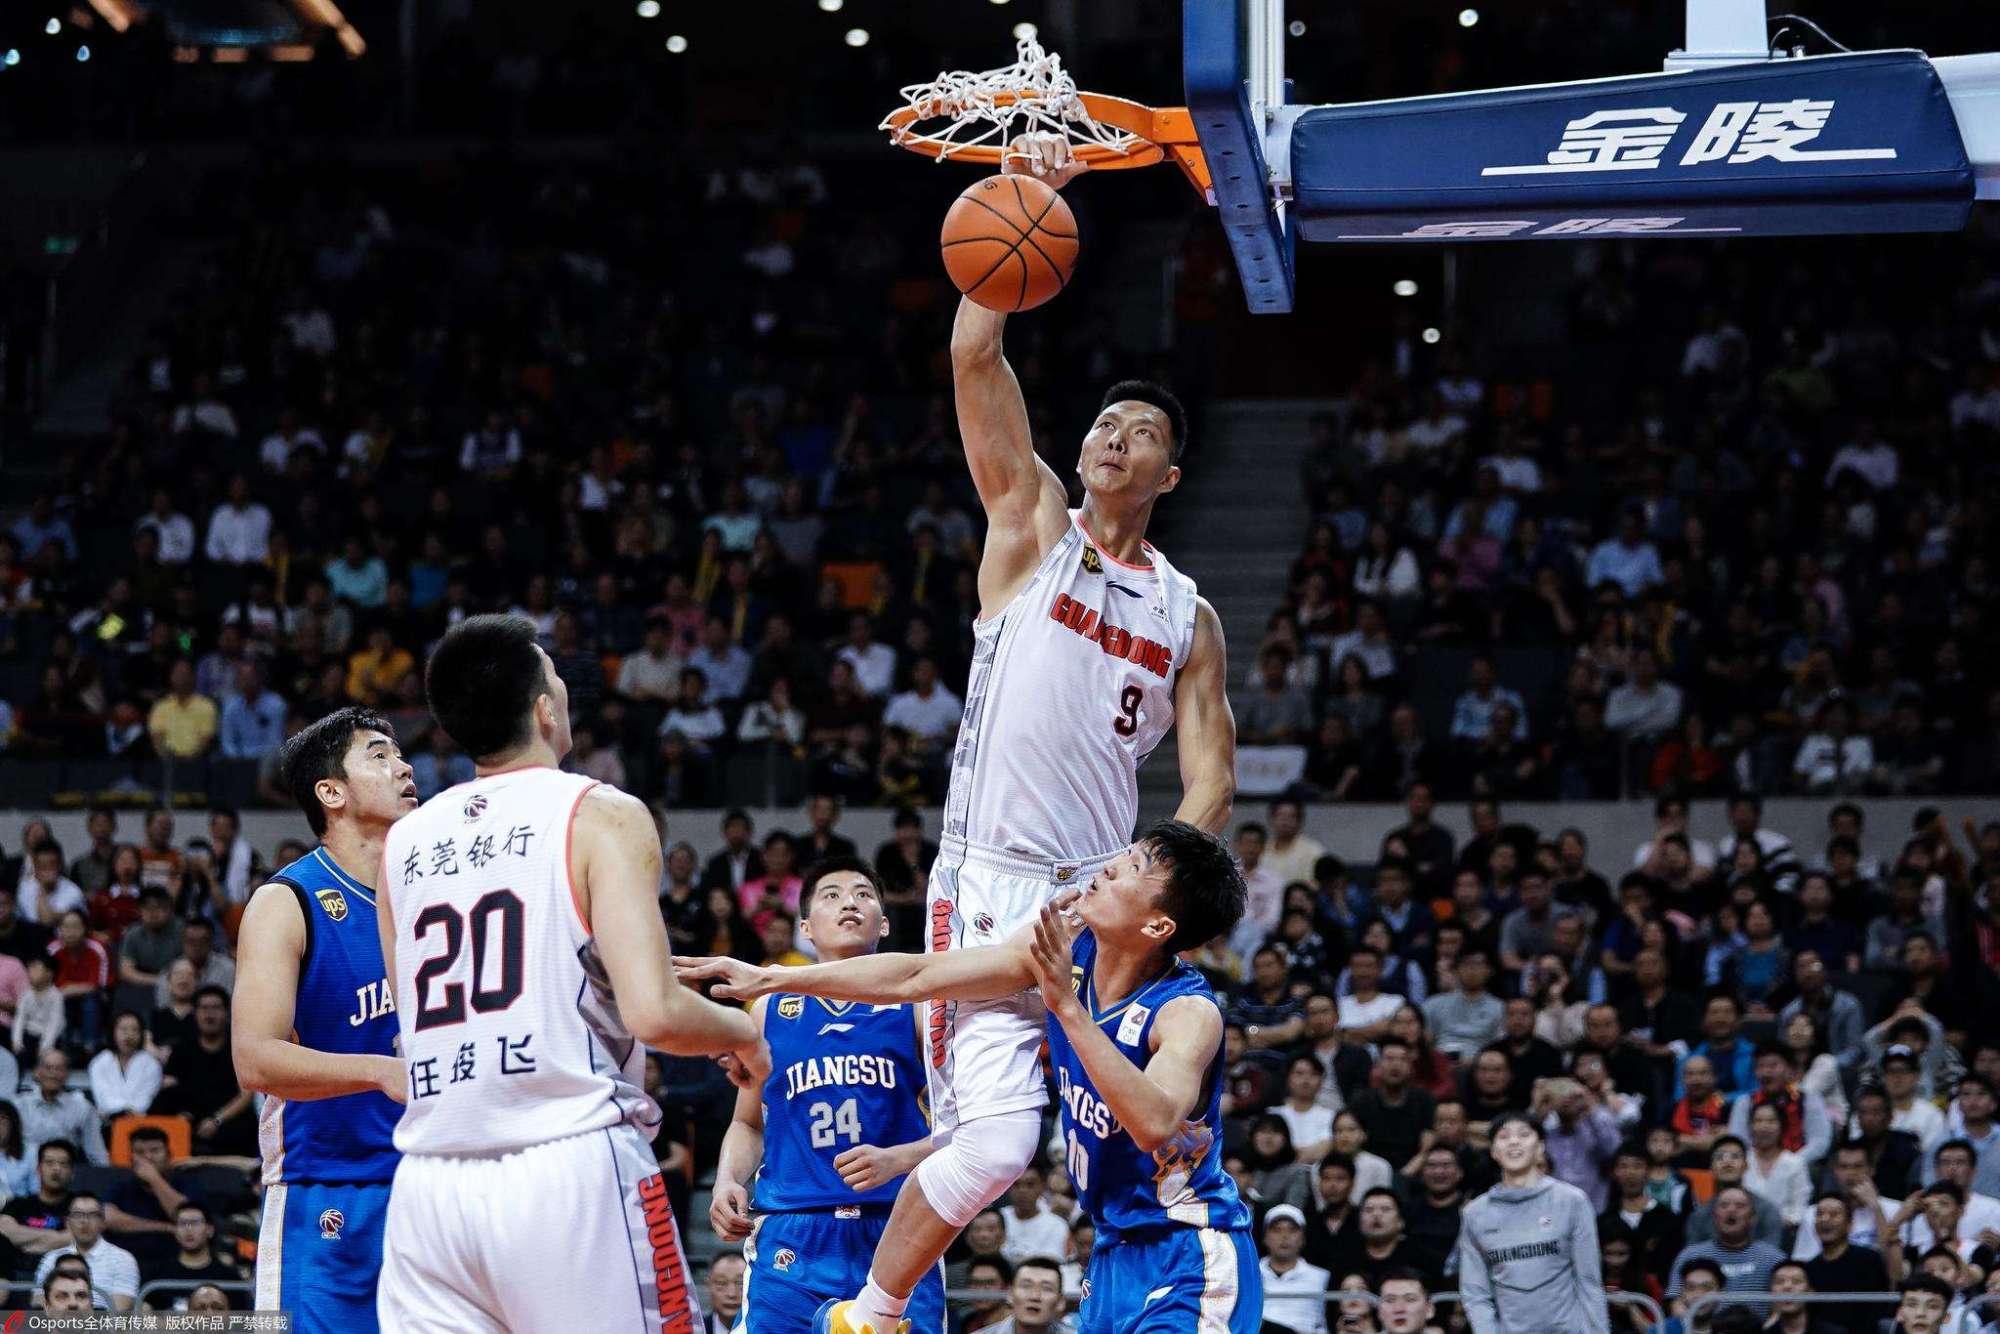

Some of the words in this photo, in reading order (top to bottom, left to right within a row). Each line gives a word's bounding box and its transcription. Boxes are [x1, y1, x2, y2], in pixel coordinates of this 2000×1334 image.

[1481, 98, 1898, 176] 金陵
[1113, 684, 1144, 737] 9
[403, 824, 536, 886] 东莞银行
[324, 898, 346, 917] ups
[413, 887, 526, 1034] 20
[409, 1033, 537, 1101] 任俊飞
[785, 1054, 897, 1101] JIANGSU
[808, 1097, 863, 1149] 24
[1067, 1128, 1090, 1192] 10
